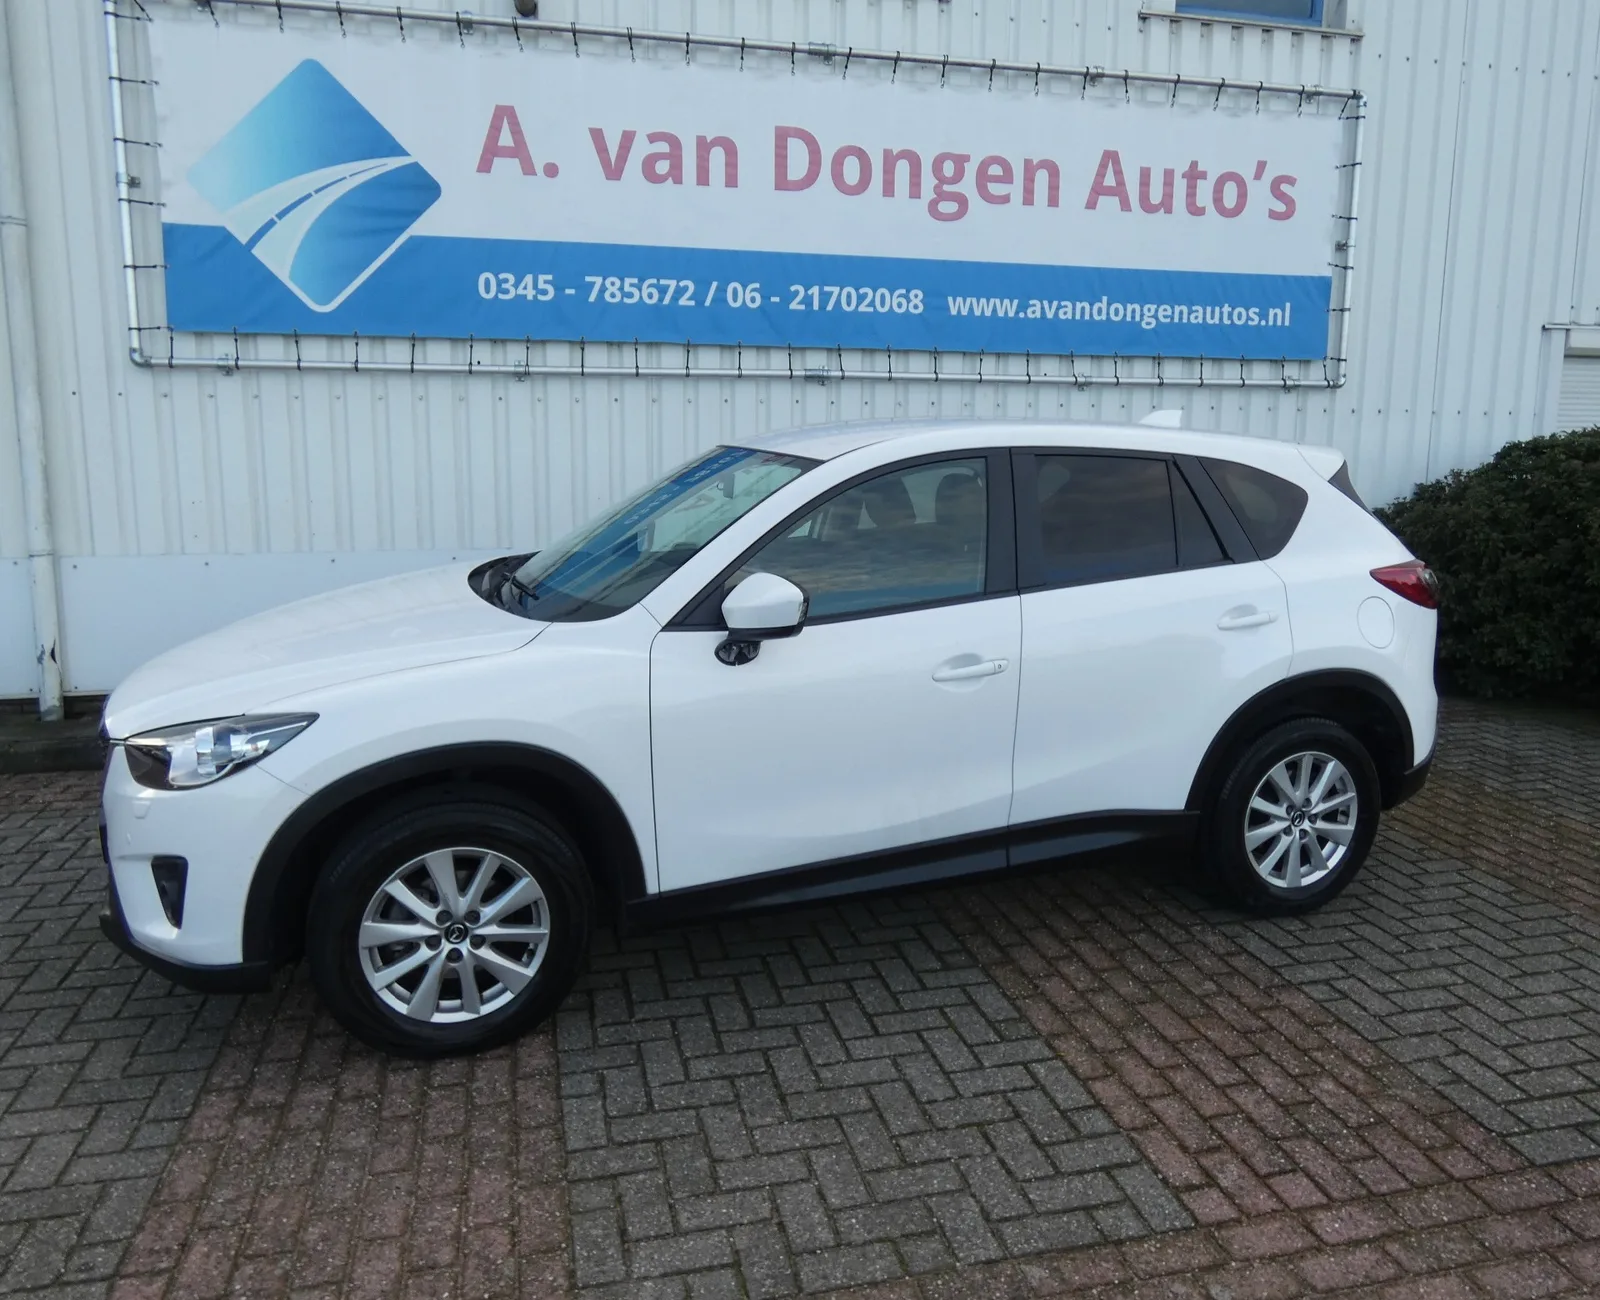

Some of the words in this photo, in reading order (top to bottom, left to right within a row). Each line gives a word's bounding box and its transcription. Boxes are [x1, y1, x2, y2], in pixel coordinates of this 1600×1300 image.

[476, 104, 559, 178] A.
[588, 127, 739, 188] van
[774, 125, 1061, 221] Dongen
[1084, 149, 1297, 221] Auto's
[477, 272, 555, 301] 0345
[584, 275, 696, 306] 785672
[704, 281, 718, 307] /
[726, 282, 762, 309] 06
[789, 284, 924, 314] 21702068
[947, 295, 1291, 330] www.avandongenautos.nl
